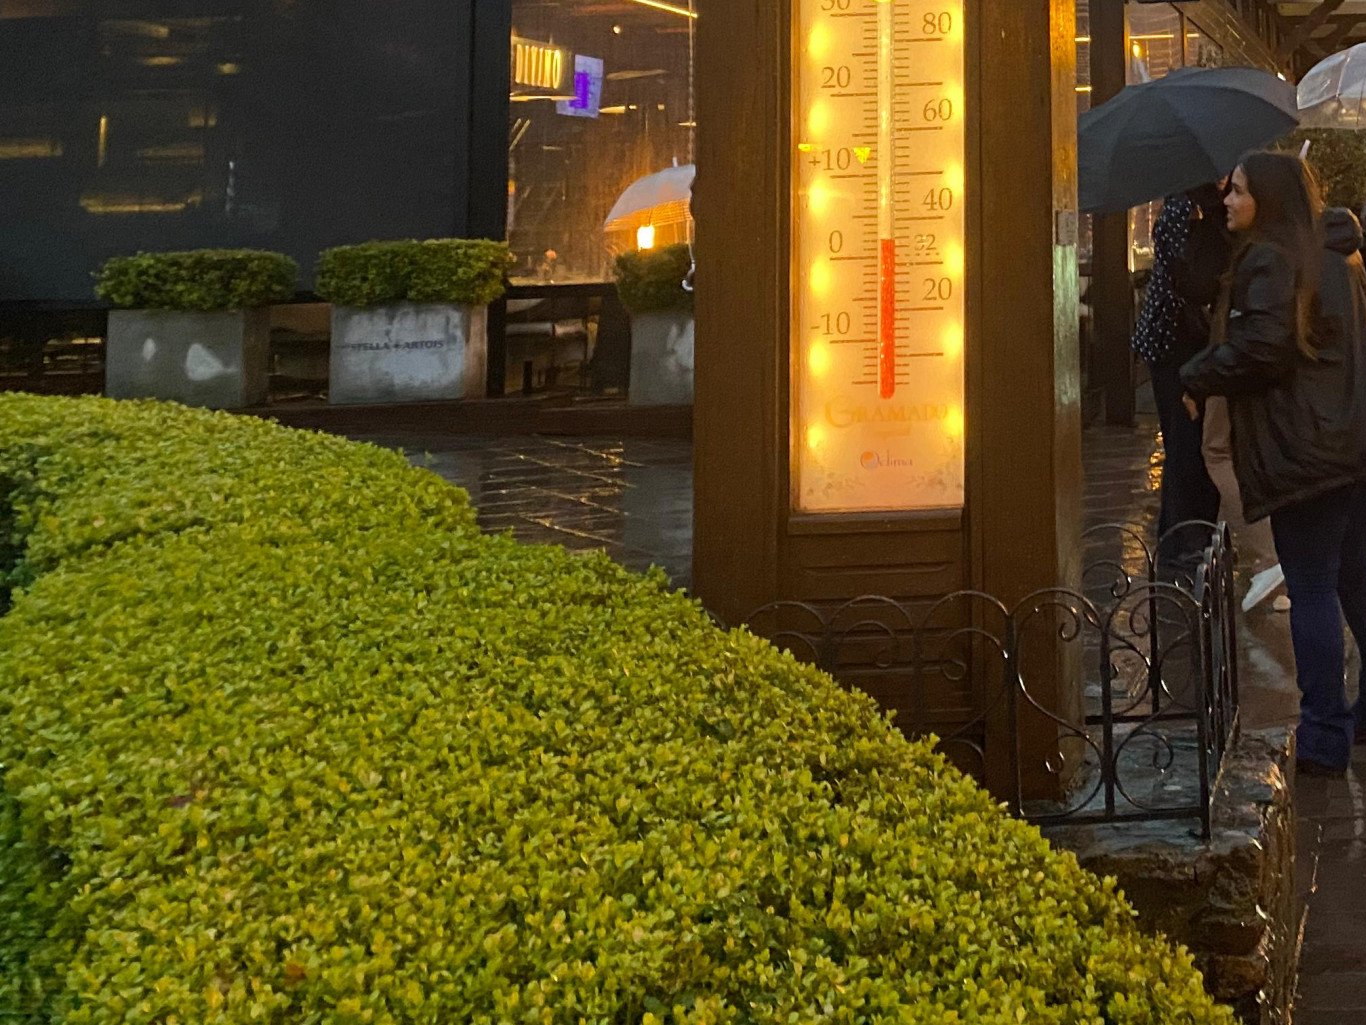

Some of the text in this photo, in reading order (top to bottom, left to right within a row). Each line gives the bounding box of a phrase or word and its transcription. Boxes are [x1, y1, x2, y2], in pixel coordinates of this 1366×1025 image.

[922, 11, 952, 35] 80
[821, 65, 851, 89] 20
[923, 98, 952, 121] 60
[808, 148, 851, 171] +10
[922, 187, 953, 211] 40
[828, 230, 843, 253] 0
[914, 234, 937, 251] 32
[922, 277, 953, 301] 20
[810, 311, 851, 335] -10
[403, 340, 444, 350] ARTOIS
